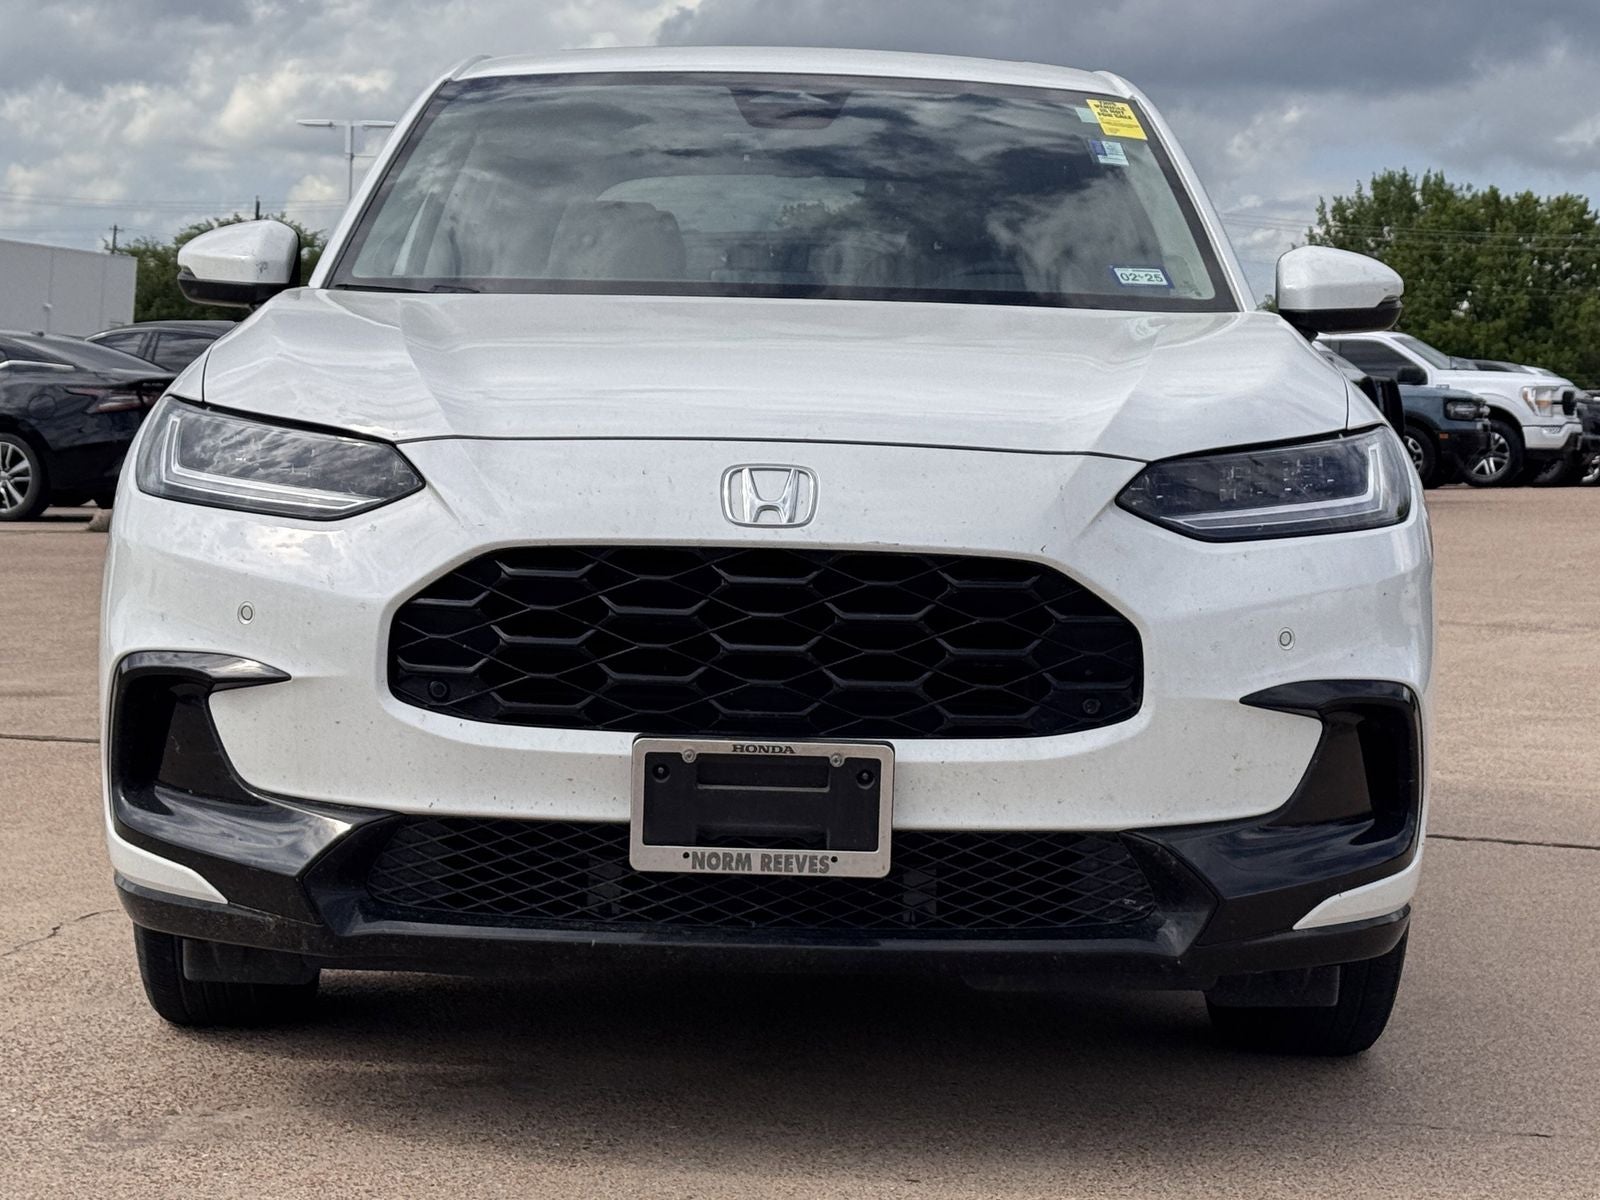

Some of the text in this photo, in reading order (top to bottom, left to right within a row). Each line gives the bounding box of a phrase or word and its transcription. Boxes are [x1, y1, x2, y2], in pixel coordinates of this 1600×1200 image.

[732, 744, 796, 755] HONDA
[691, 851, 830, 874] NORM REEVES
